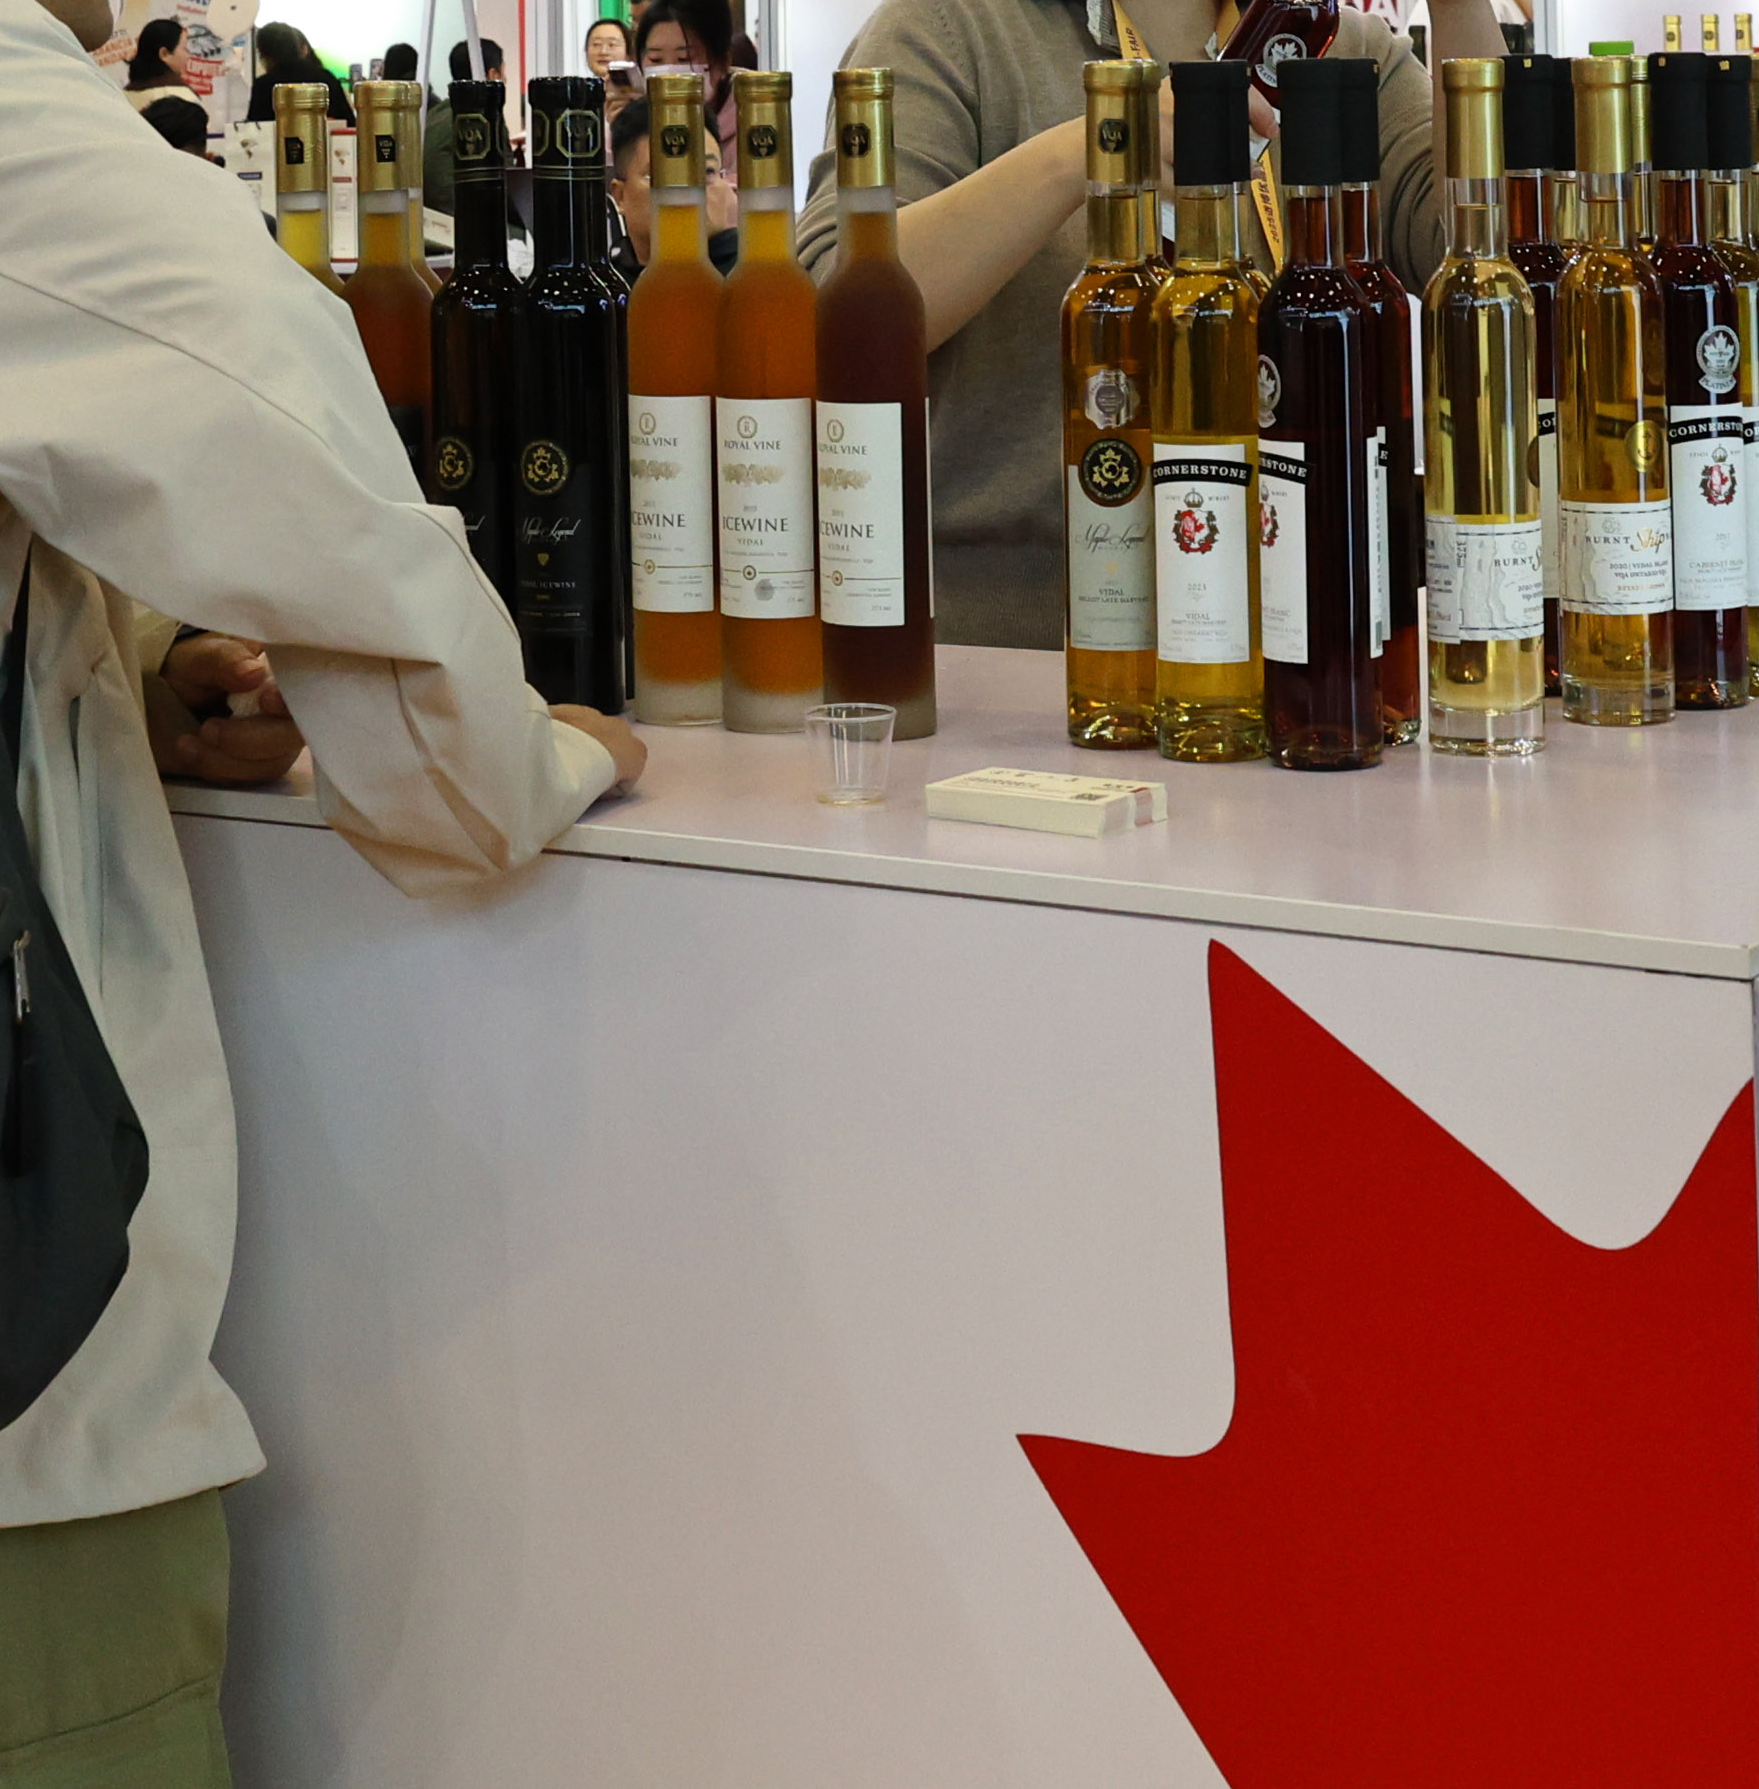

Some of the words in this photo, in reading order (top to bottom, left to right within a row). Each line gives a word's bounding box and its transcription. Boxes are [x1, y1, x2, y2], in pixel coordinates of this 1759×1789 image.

[754, 440, 782, 451] VINE
[1153, 465, 1247, 480] CORNERSTONE
[632, 512, 687, 528] CEWINE
[722, 516, 790, 532] ICEWINE
[819, 520, 875, 538] CEWINE
[1586, 534, 1631, 545] BURNT
[1494, 556, 1534, 568] BURNT
